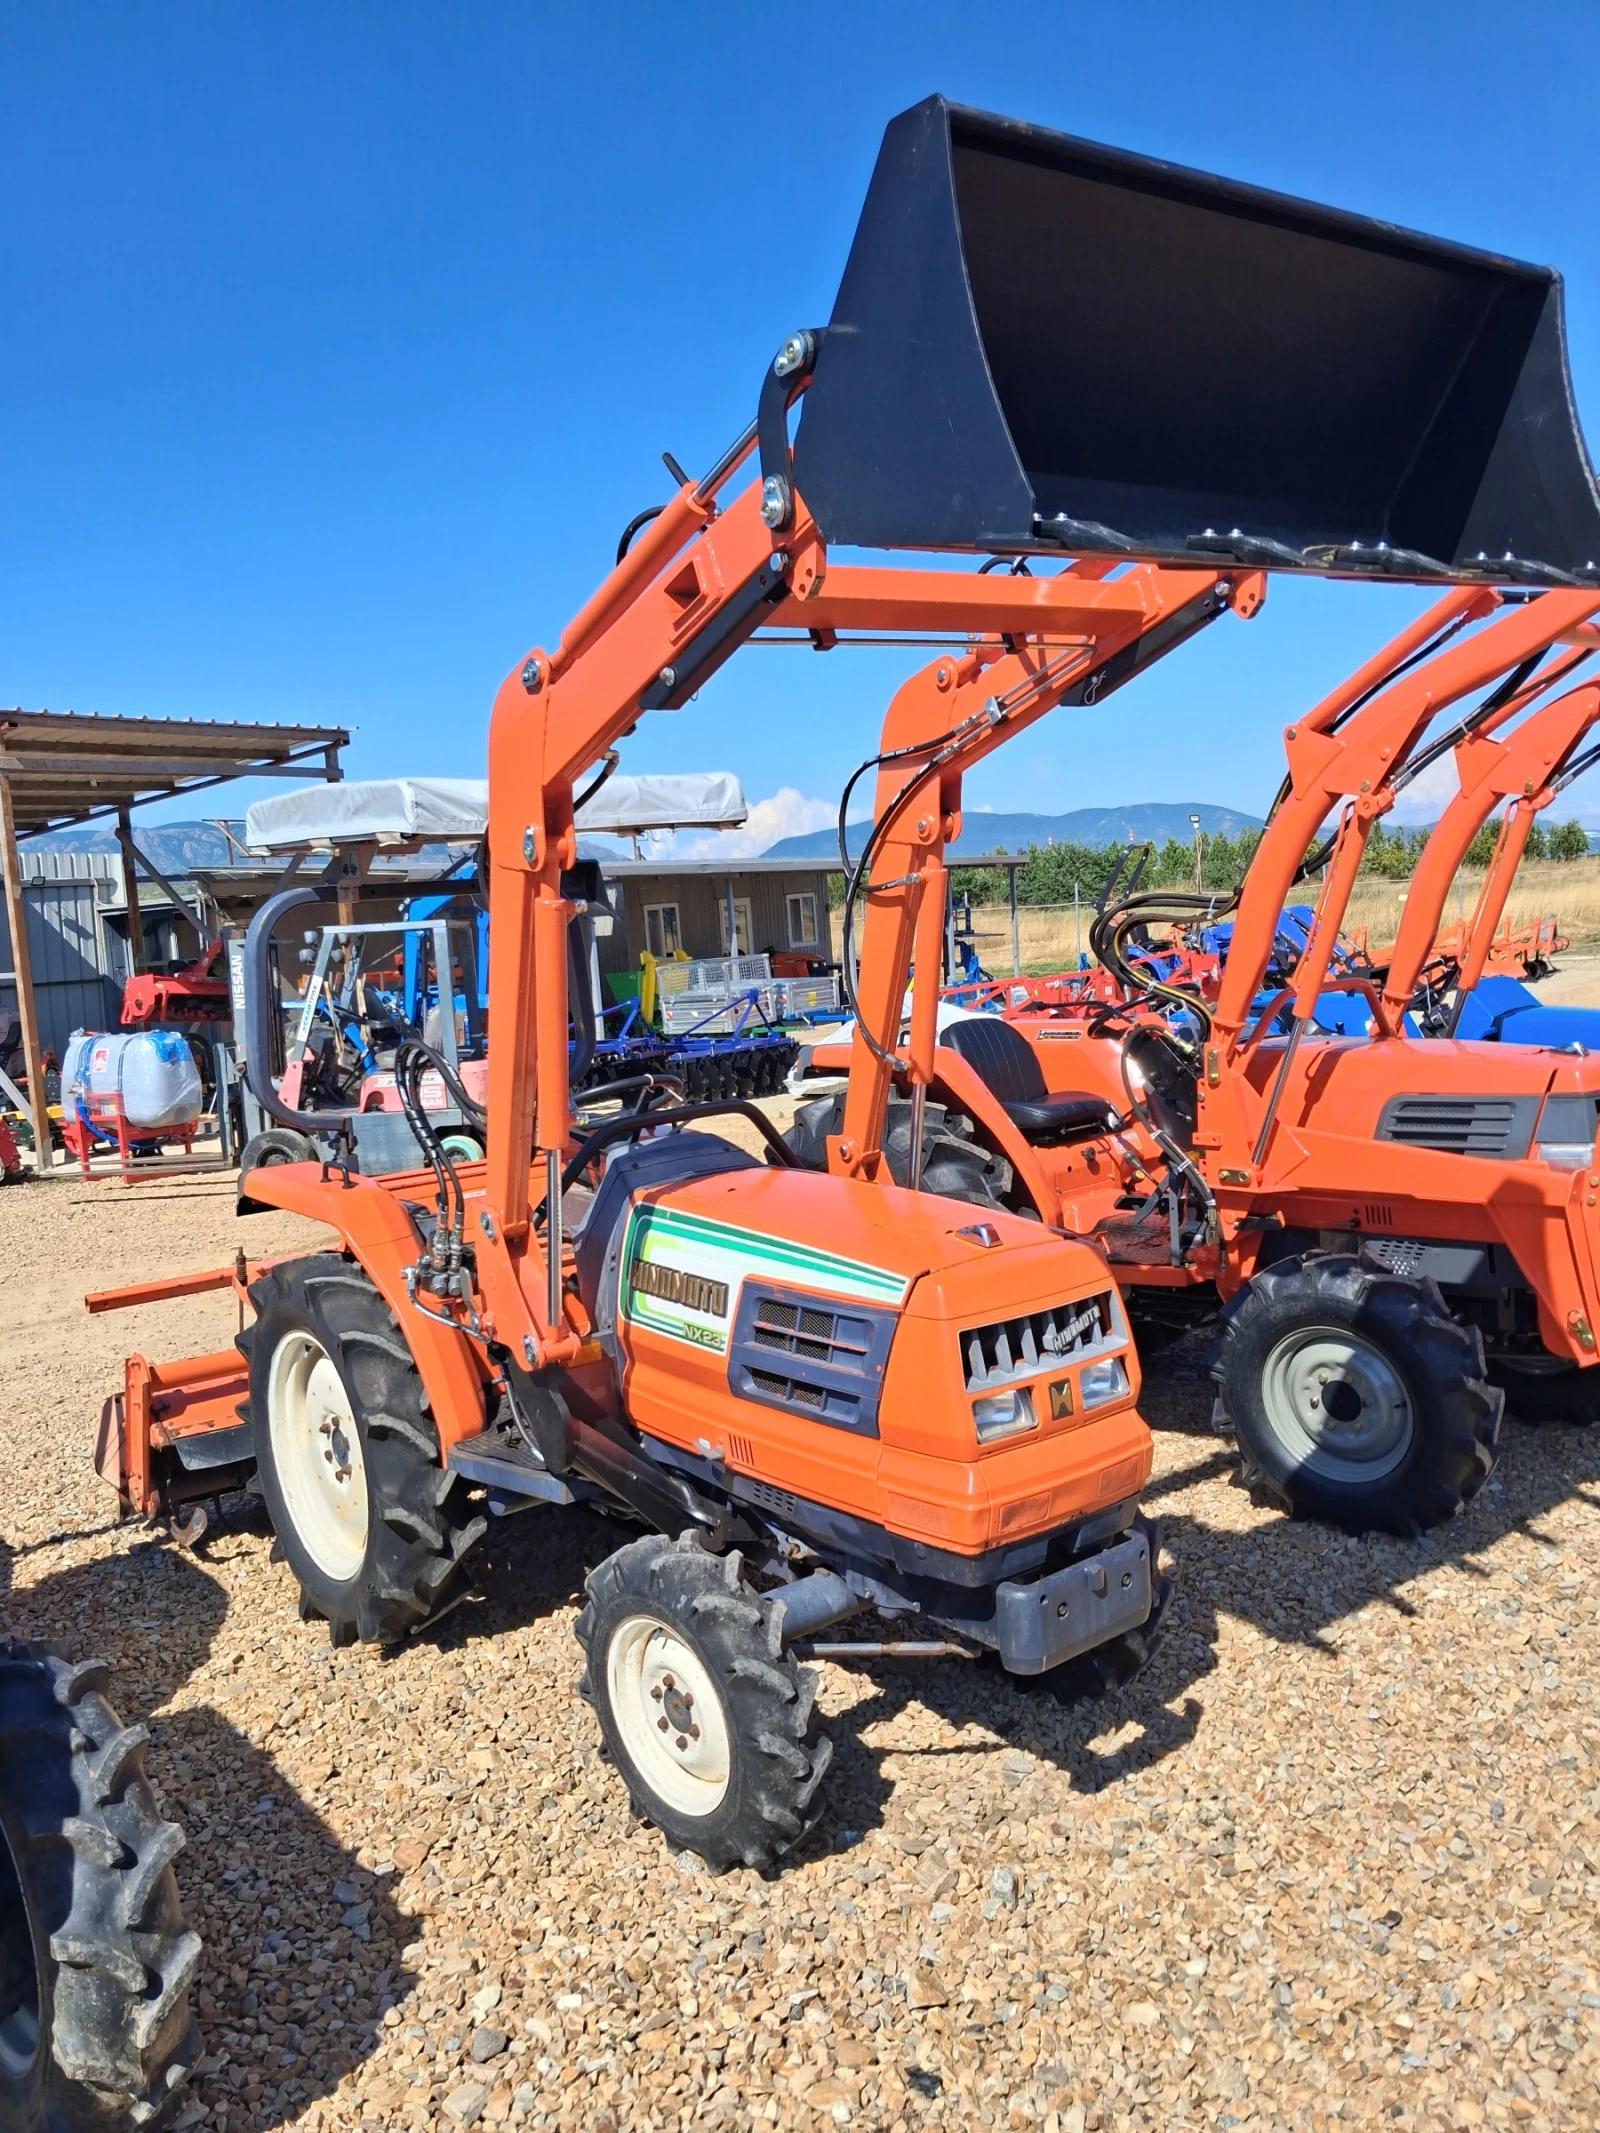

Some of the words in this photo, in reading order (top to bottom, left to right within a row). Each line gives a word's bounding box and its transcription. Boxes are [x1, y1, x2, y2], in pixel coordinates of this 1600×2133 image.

[231, 954, 246, 1010] NISSAN
[631, 1259, 729, 1319] HINOMOTO
[682, 1323, 722, 1348] NX23
[1052, 1304, 1101, 1351] HINOMOTO
